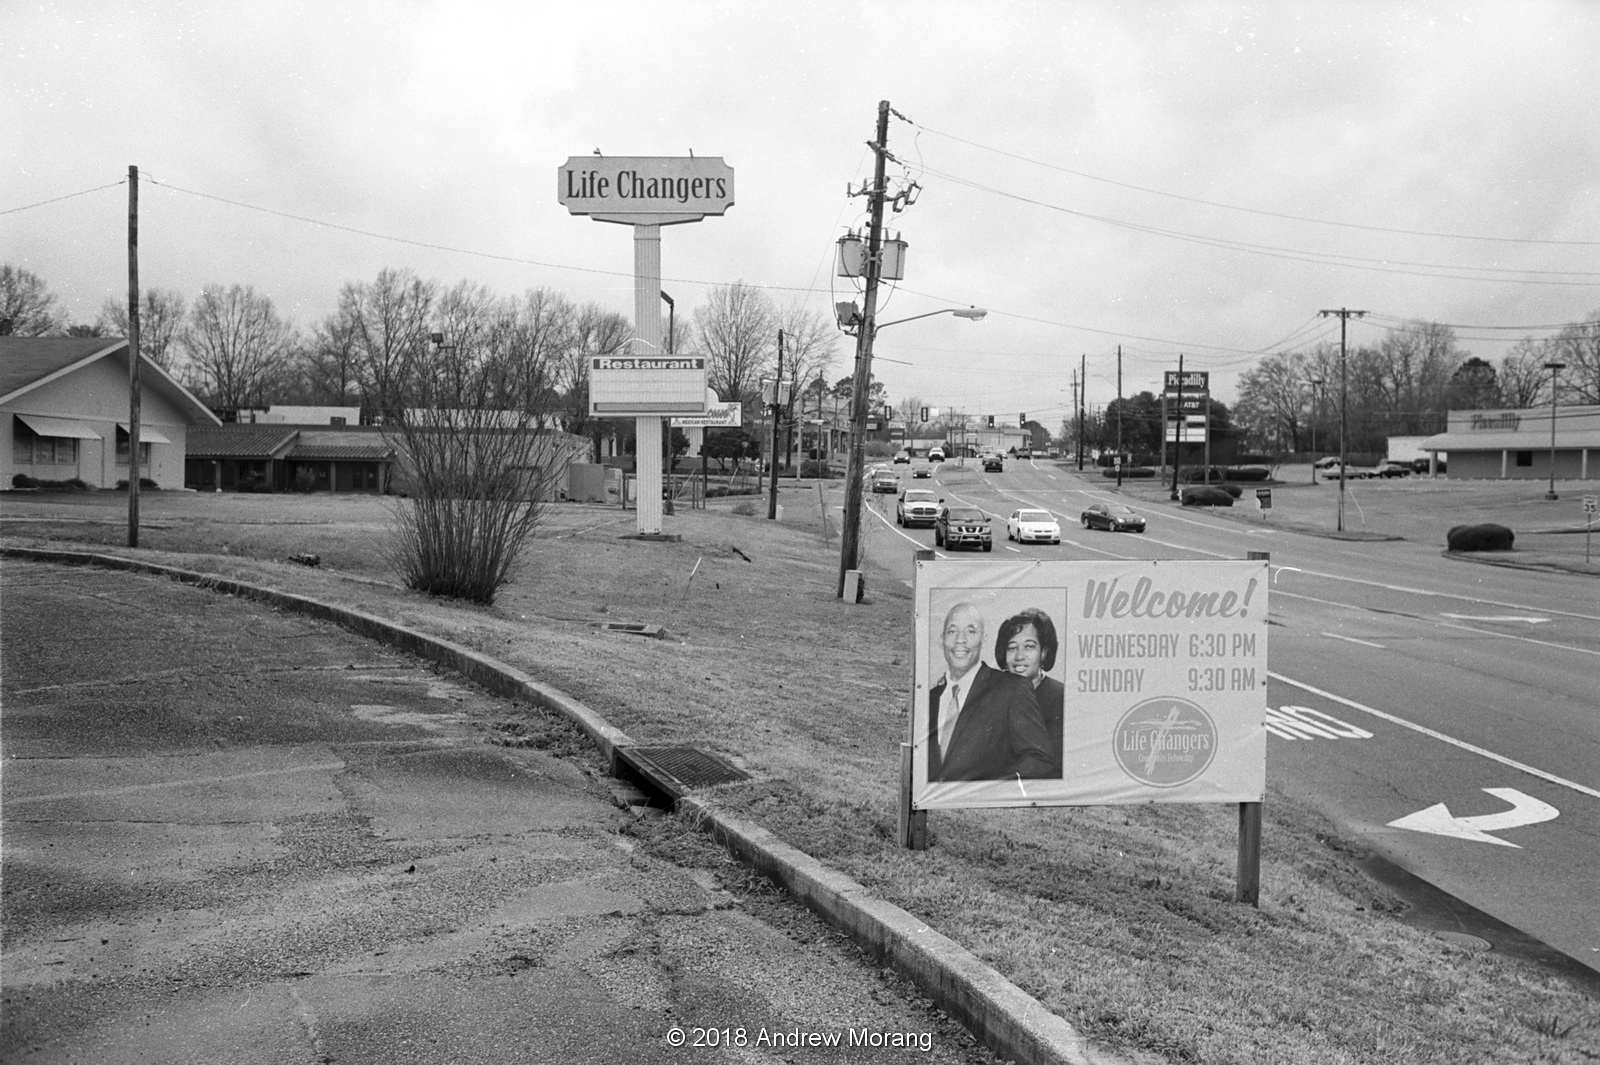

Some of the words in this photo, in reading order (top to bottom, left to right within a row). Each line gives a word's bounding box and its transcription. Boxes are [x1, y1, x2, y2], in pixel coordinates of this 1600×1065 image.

[566, 170, 609, 199] Life
[617, 170, 727, 203] Changers
[599, 359, 698, 370] Restaurant
[1183, 401, 1200, 409] AT&T
[1083, 577, 1258, 619] Welcome!
[1078, 634, 1178, 658] WEDNESDAY
[1188, 633, 1226, 658] 6:30
[1231, 632, 1256, 658] PM
[1078, 668, 1144, 693] SUNDAY
[1188, 668, 1226, 692] 9:30
[1231, 667, 1256, 691] AM
[1123, 730, 1147, 751] Life
[1150, 730, 1210, 753] Changers
